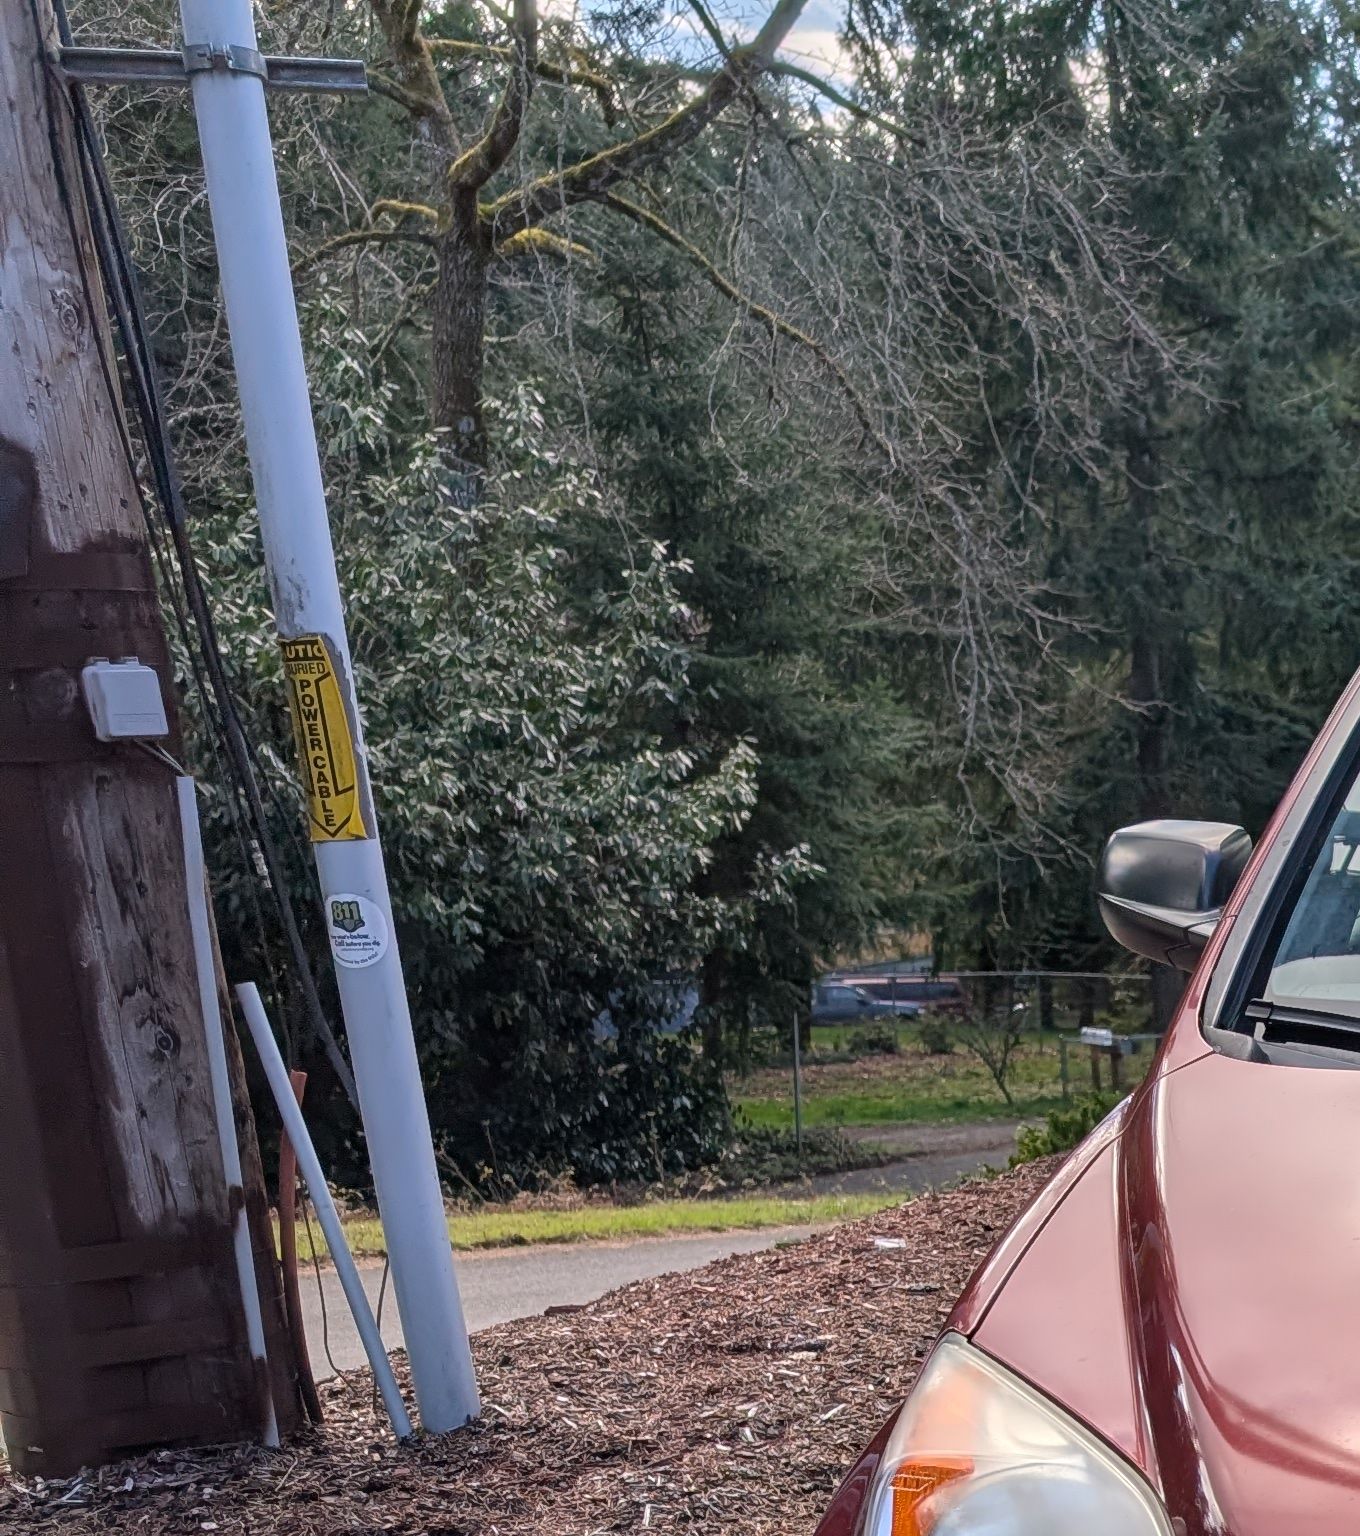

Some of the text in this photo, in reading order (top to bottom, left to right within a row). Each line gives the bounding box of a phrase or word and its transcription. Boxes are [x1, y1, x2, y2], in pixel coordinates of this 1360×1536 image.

[299, 680, 336, 826] POWER CABLE
[332, 902, 359, 920] 811
